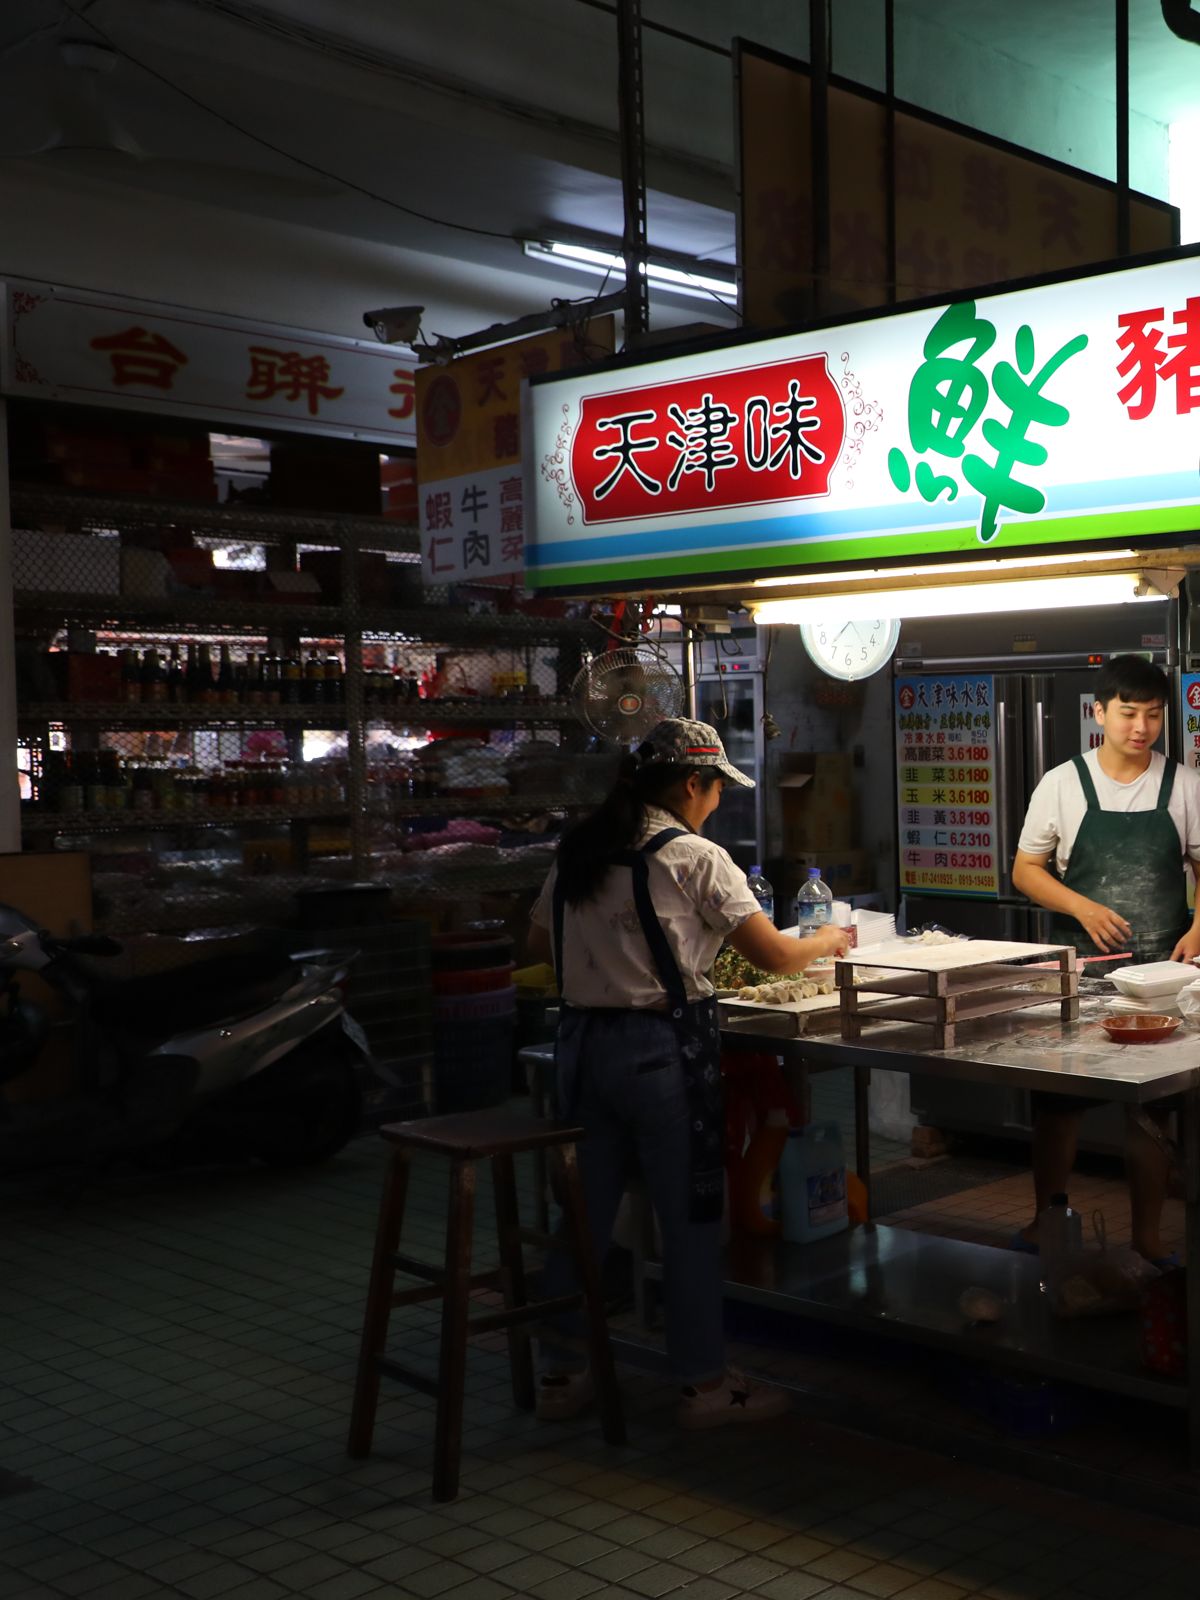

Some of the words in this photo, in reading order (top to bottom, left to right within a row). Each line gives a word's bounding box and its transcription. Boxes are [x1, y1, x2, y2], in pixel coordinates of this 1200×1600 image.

[887, 300, 1088, 541] 鮮
[593, 379, 825, 501] 天津味
[499, 476, 523, 562] 高麗菜
[425, 491, 455, 574] 蝦仁
[461, 485, 489, 569] 牛肉
[820, 631, 826, 645] 8
[869, 633, 876, 647] 4
[831, 646, 837, 659] 7
[844, 652, 852, 666] 6
[860, 647, 868, 661] 5
[918, 682, 989, 708] 天津味水餃
[905, 746, 945, 760] 高麗菜
[948, 747, 964, 760] 3.6
[966, 747, 988, 760] 180
[949, 768, 965, 782] 3.6
[966, 768, 989, 782] 180
[906, 788, 946, 803] 玉米
[949, 789, 965, 803] 3.6
[967, 790, 989, 804] 180
[950, 811, 966, 825] 3.8
[968, 811, 990, 825] 190
[950, 832, 966, 846] 6.2
[968, 833, 990, 847] 310
[908, 850, 947, 867] 牛肉
[951, 853, 967, 867] 6.2
[968, 854, 991, 868] 310
